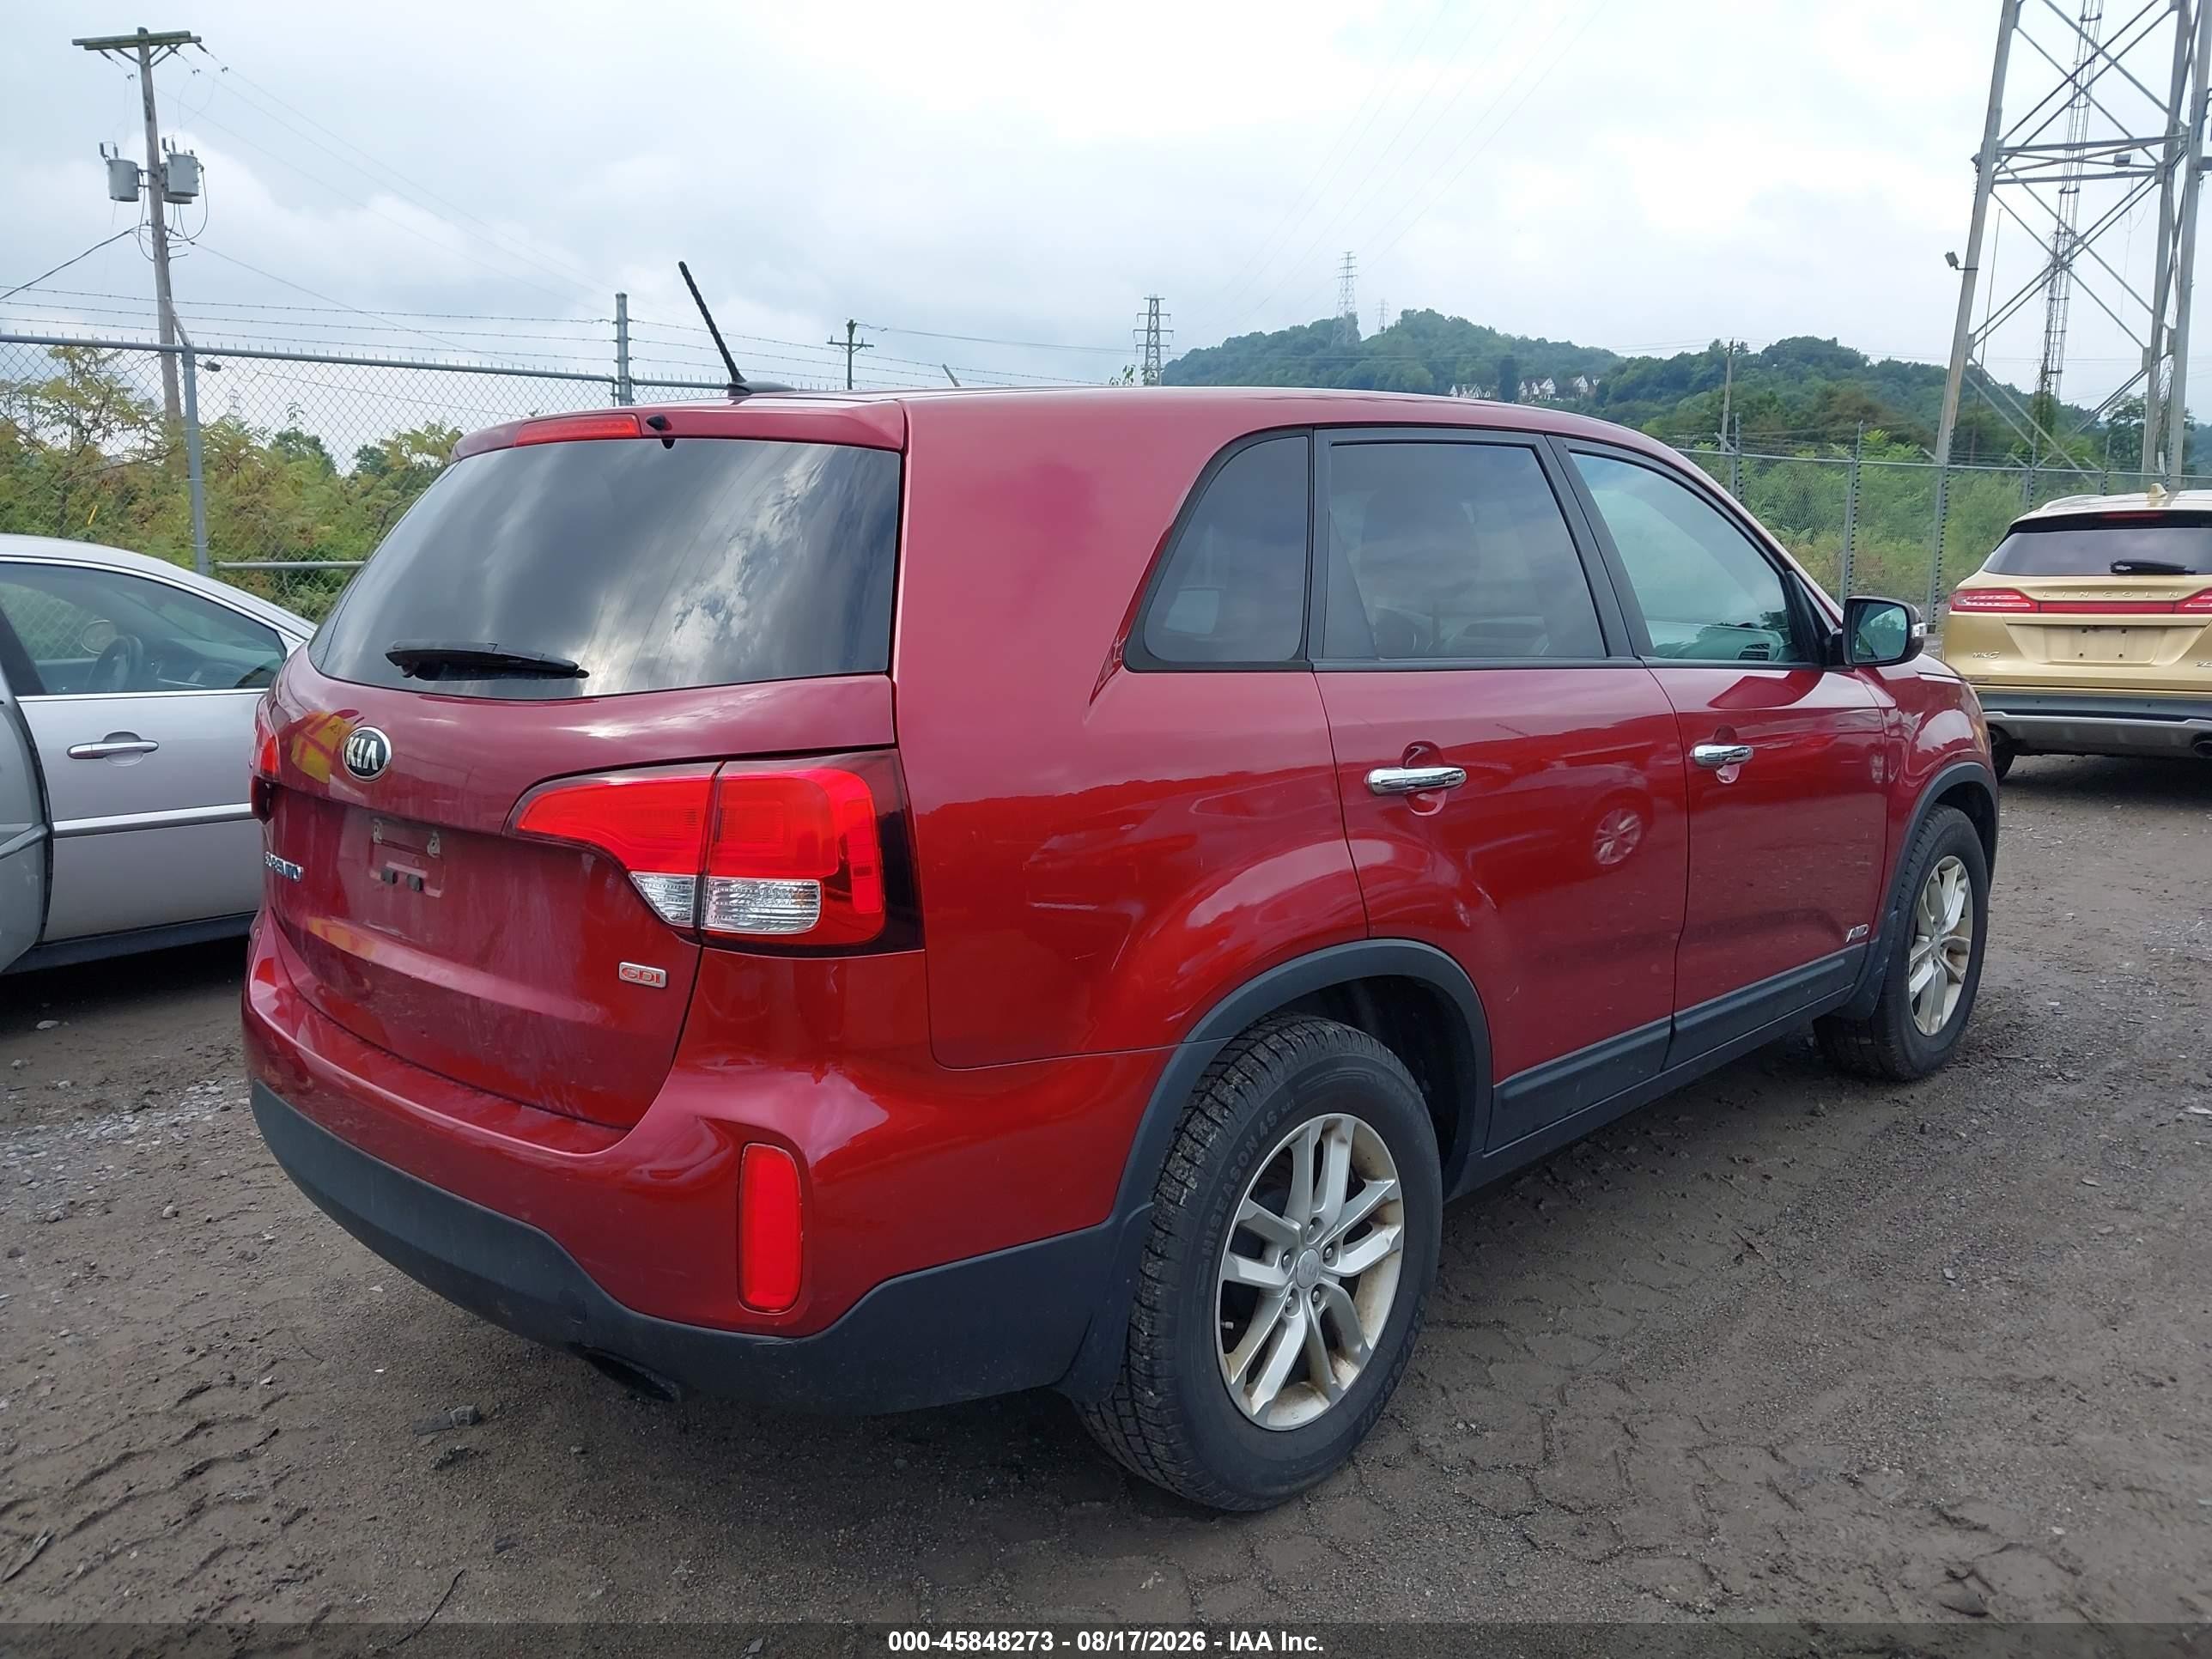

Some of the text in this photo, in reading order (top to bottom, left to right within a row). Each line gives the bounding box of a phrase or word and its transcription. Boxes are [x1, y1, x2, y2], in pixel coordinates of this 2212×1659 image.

[2042, 590, 2179, 599] LINCOLN
[346, 736, 379, 771] KIA
[622, 967, 660, 984] GDI
[1201, 1134, 1260, 1256] HISEASON
